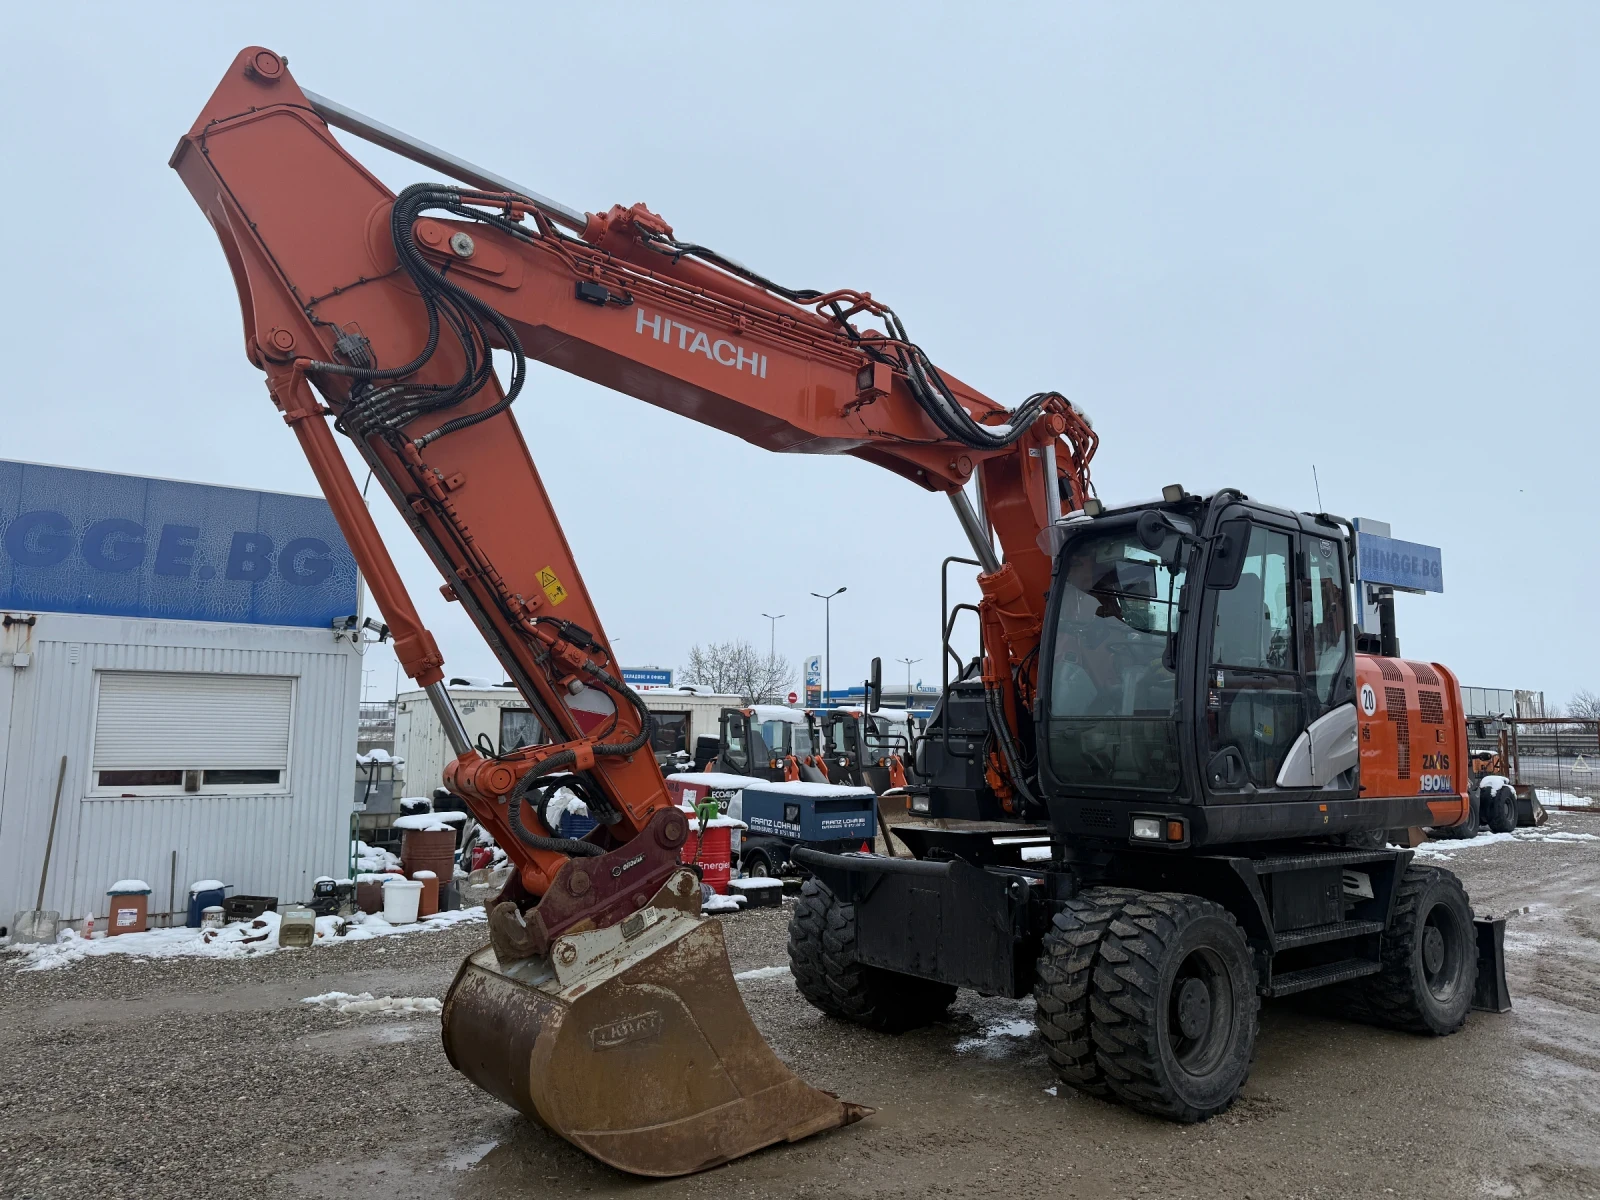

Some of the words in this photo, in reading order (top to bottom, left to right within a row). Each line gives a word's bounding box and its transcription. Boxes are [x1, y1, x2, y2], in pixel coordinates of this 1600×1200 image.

[635, 307, 768, 380] HITACHI
[4, 510, 335, 587] GGE.BG
[1361, 546, 1440, 579] HENGGE.BG
[1363, 689, 1374, 710] 20
[1422, 751, 1450, 770] ZAXIS
[750, 816, 773, 827] FRANZ
[773, 820, 792, 830] LOHR
